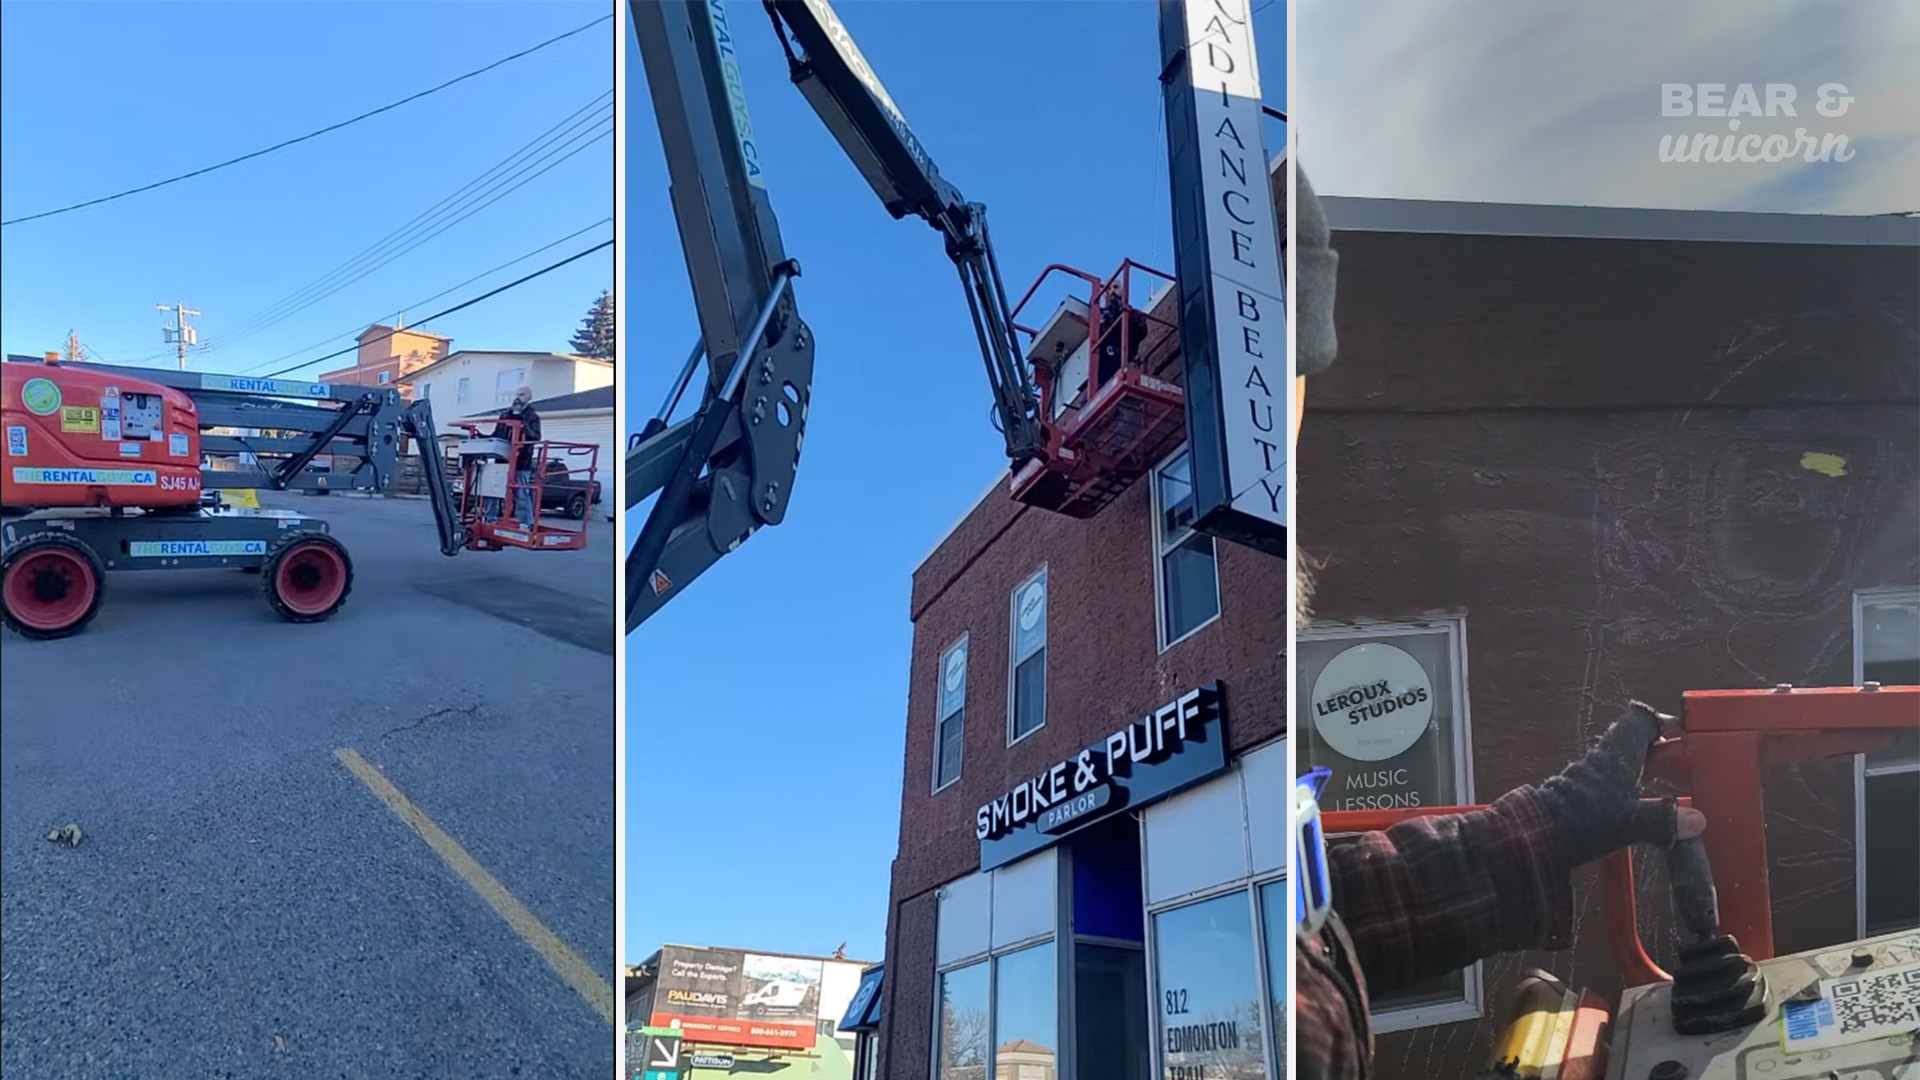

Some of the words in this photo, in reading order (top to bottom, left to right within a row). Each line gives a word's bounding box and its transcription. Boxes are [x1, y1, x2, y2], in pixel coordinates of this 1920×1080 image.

[1236, 289, 1283, 513] BEAUTY
[160, 475, 186, 490] SJ45
[1316, 680, 1392, 717] LEROUX
[1348, 687, 1428, 725] STUDIOS
[976, 760, 1067, 840] SMOKE
[1073, 748, 1098, 792] &
[1106, 687, 1200, 777] PUFF
[1345, 768, 1408, 791] MUSIC
[1048, 793, 1096, 827] PARLOR
[1165, 988, 1189, 1016] 812
[1167, 1020, 1238, 1054] EDMONTON
